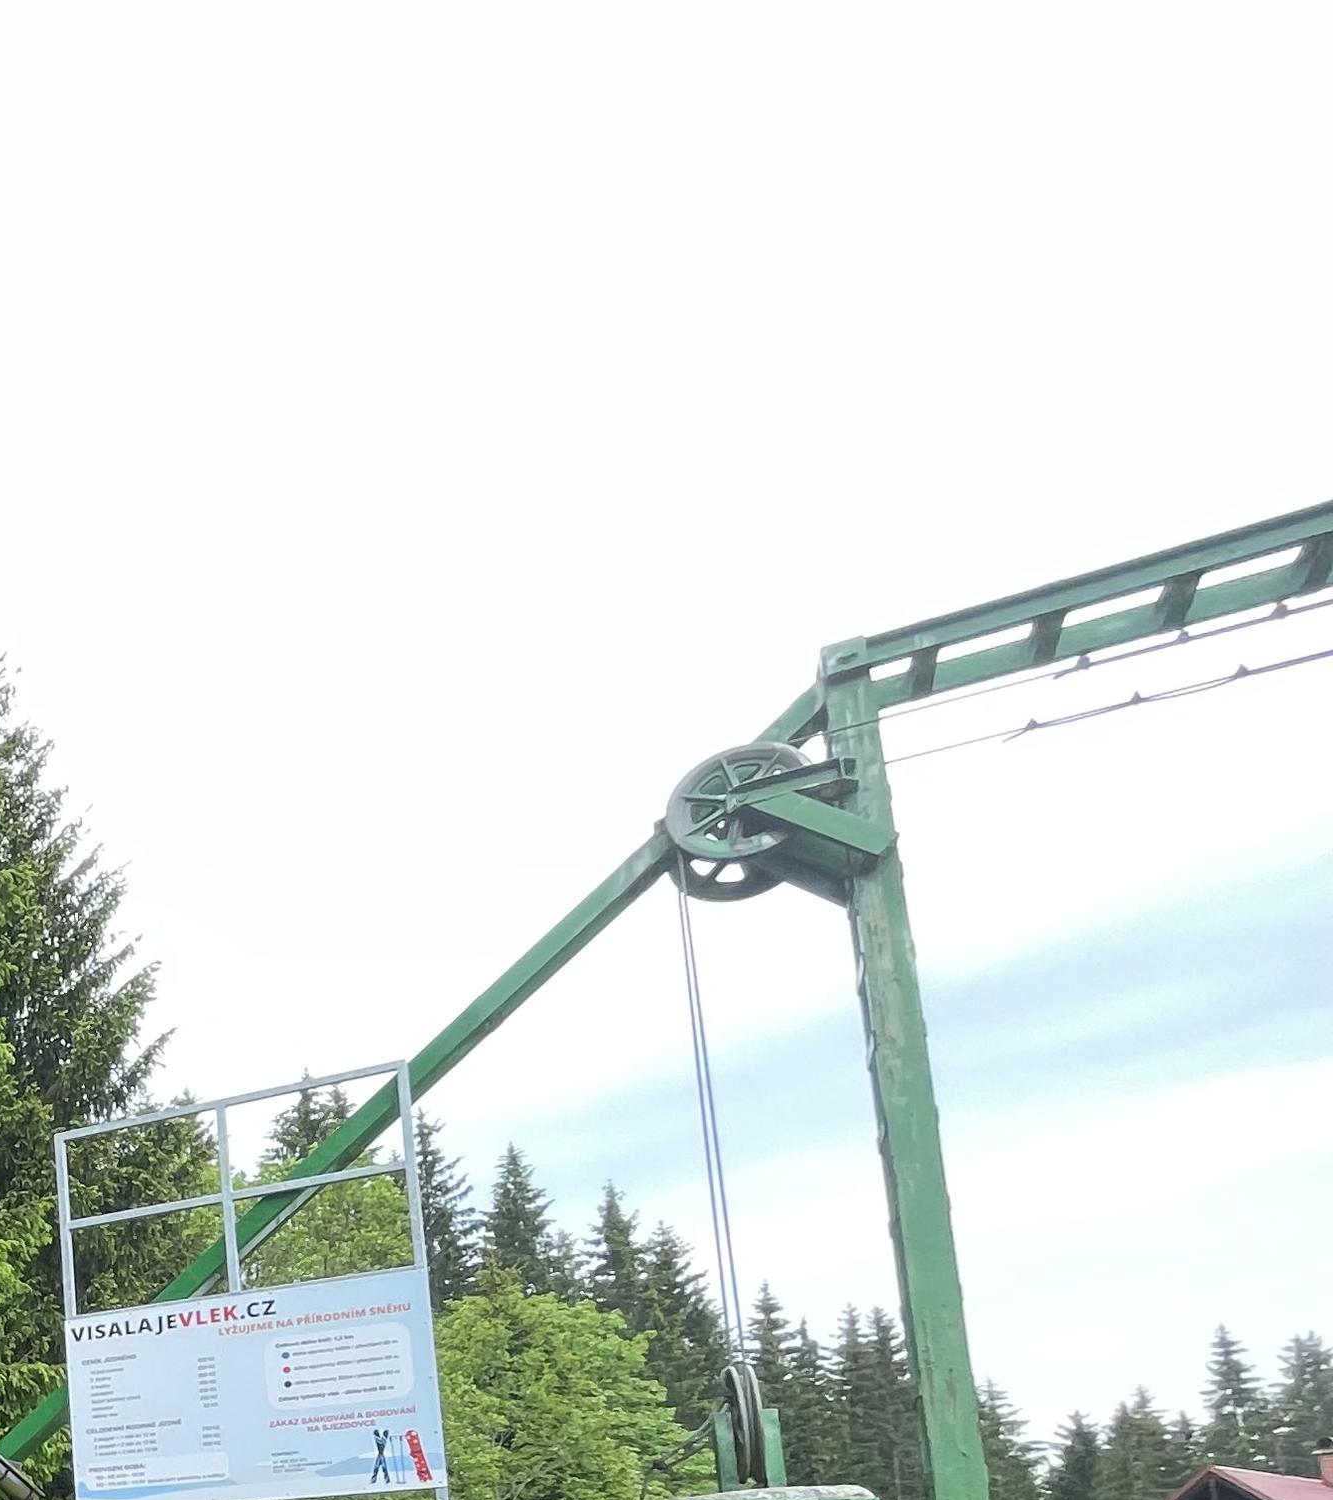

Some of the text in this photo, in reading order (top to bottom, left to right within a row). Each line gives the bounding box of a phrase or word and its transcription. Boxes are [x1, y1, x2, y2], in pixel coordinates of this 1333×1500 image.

[71, 1300, 277, 1343] VISALAJEVLEK.CZ
[218, 1302, 412, 1337] LYŽUJEME NA PŘÍRODNÍM SNĚHU
[269, 1417, 299, 1429] ZÁKAZ
[357, 1411, 364, 1419] A
[307, 1425, 320, 1433] NA
